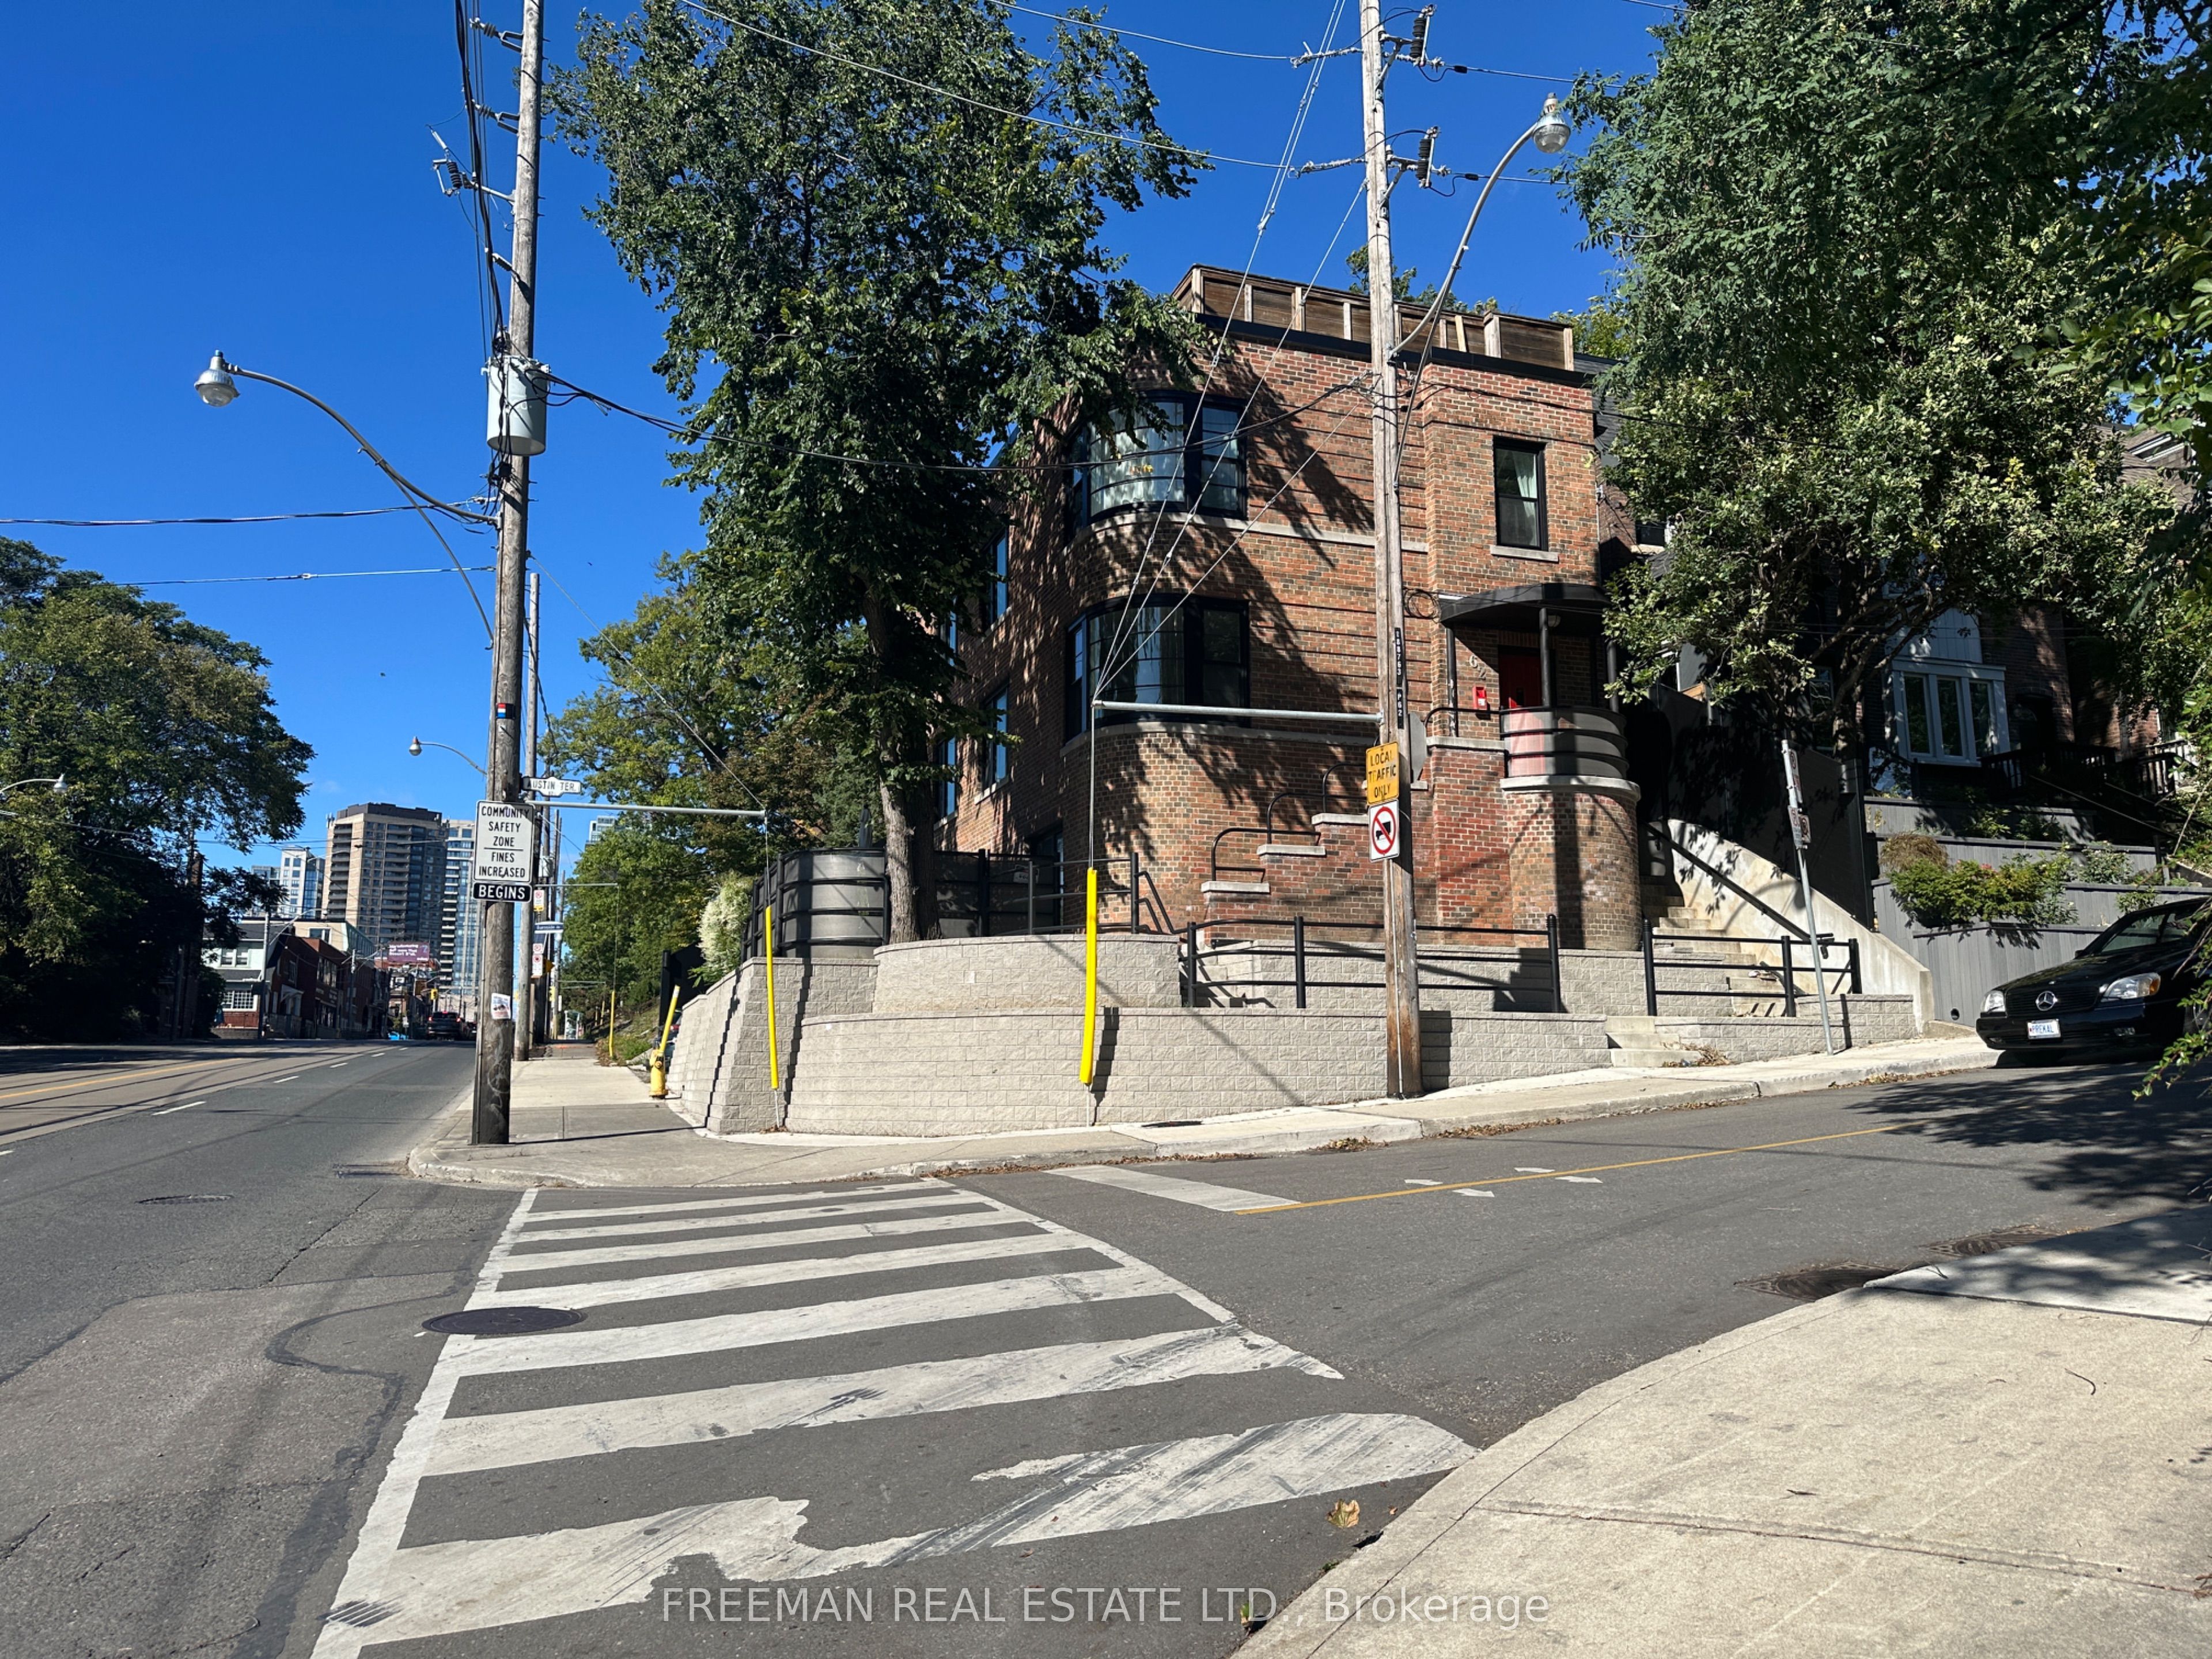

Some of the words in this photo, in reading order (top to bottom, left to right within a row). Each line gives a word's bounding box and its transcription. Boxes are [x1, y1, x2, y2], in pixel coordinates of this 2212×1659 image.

[1469, 655, 1486, 679] 62
[1370, 750, 1392, 766] LOCAL
[527, 780, 556, 789] AUSTIN
[1374, 783, 1391, 798] ONLY
[482, 806, 529, 819] COMMUNITY
[488, 821, 521, 832] SAFETY
[493, 836, 515, 847] ZONE
[491, 852, 515, 863] FINES
[479, 866, 525, 878] INCREASED
[479, 885, 525, 899] BEGINS
